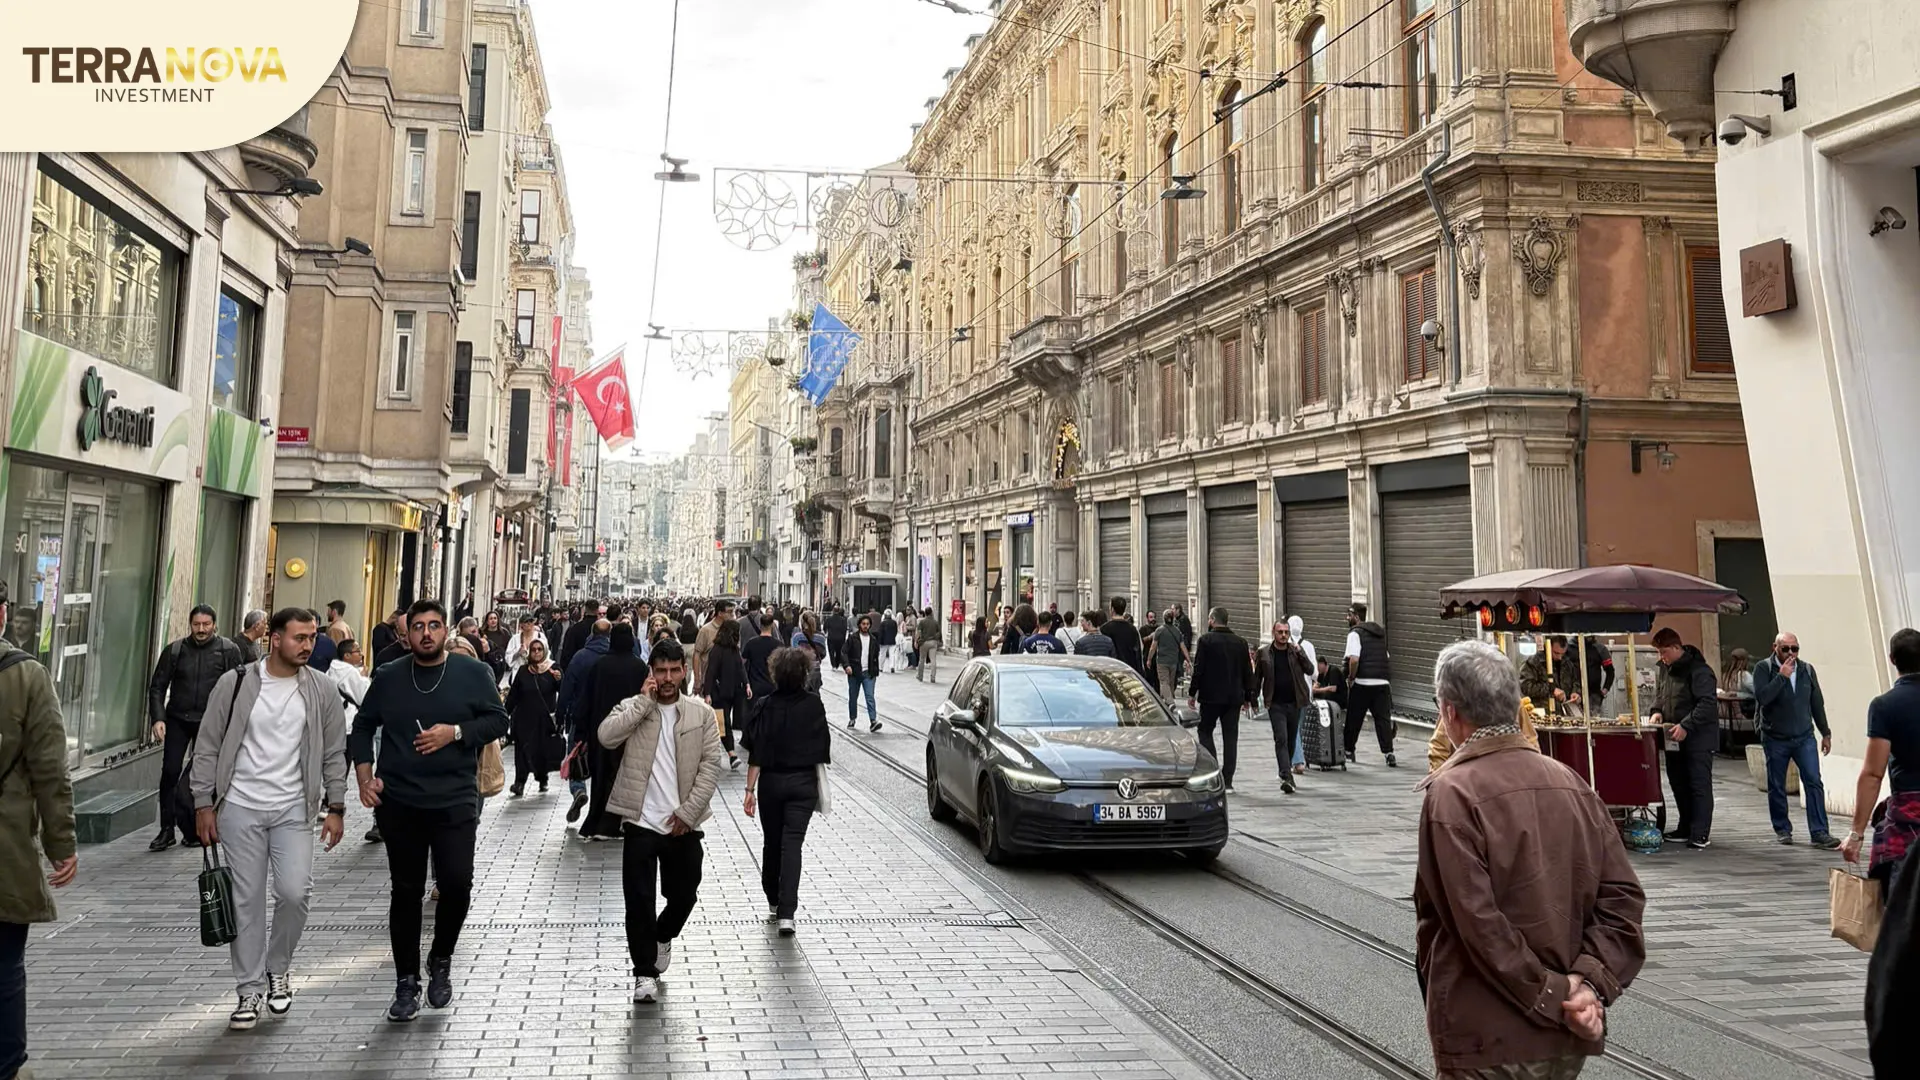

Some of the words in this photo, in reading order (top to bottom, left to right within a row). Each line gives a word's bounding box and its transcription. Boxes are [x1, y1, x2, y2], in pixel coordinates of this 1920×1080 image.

[100, 389, 155, 448] Garanti
[1101, 806, 1114, 819] 34
[1118, 806, 1132, 819] BA
[1137, 806, 1163, 819] 5967
